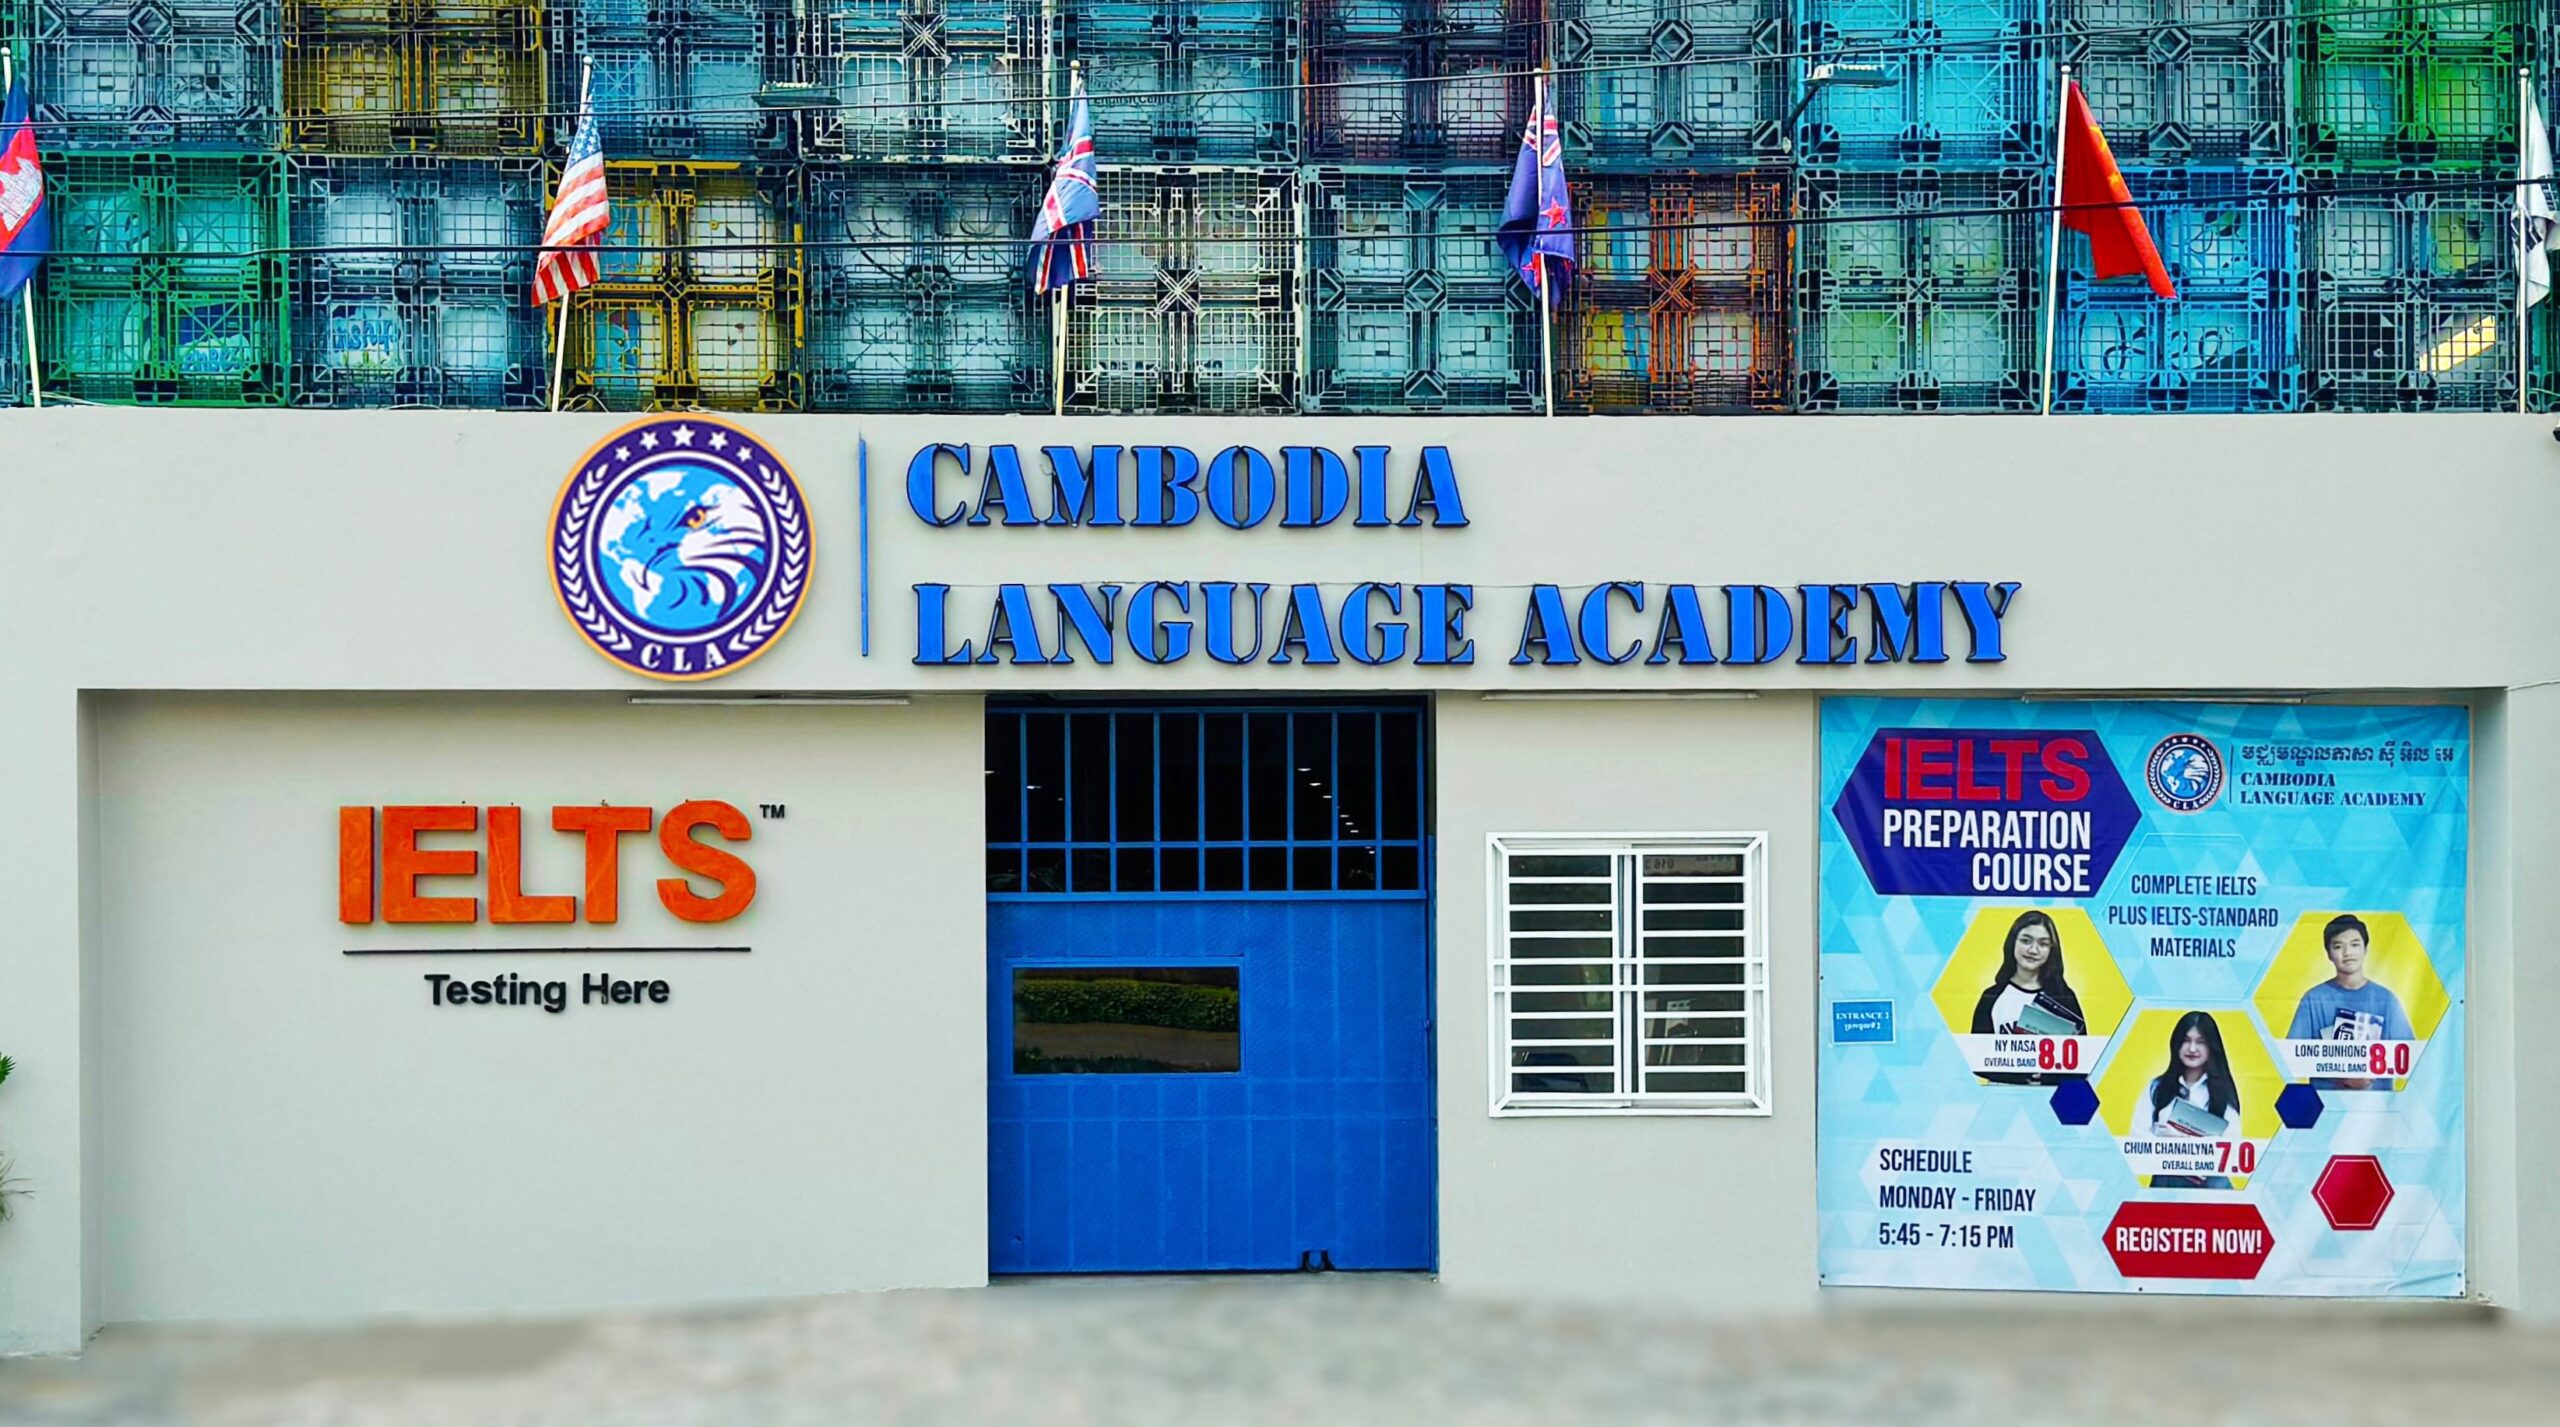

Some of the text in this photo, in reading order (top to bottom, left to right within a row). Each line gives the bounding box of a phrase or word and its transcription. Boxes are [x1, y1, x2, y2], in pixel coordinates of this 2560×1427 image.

[906, 443, 1470, 531] CAMBODIA
[912, 581, 2021, 667] LANGUAGE ACADEMY
[640, 641, 727, 672] CLA
[1885, 739, 2090, 801] IELTS
[2241, 773, 2335, 787] CAMBODIA
[2241, 791, 2426, 806] LANGUAGE ACADEMY
[1884, 809, 2090, 849] PREPARATION
[339, 799, 757, 928] IELTS
[1972, 853, 2090, 892] COURSE
[2132, 875, 2256, 895] COMPLETE IELTS
[2109, 906, 2278, 926] PLUS IELTS-STANDARD
[2151, 938, 2235, 957] MATERIALS
[424, 973, 670, 1013] Testing Here
[1836, 1012, 1882, 1020] ENTRANCE
[1995, 1040, 2036, 1052] NY NASA
[2039, 1038, 2079, 1070] 8.0
[2295, 1045, 2367, 1058] LONG BUNHONG
[1984, 1058, 2036, 1067] OVERALL BAND
[2316, 1063, 2367, 1072] OVERALL BAND
[2370, 1043, 2410, 1075] 8.0
[1880, 1148, 1972, 1174] SCHEDULE
[2124, 1142, 2214, 1155] CHUM CHANAILYNA
[2216, 1142, 2255, 1174] 7.0
[2162, 1160, 2214, 1170] OVERALL BAND
[1880, 1186, 1956, 1210] MONDAY
[1975, 1188, 2036, 1212] FRIDAY
[1880, 1223, 1920, 1246] 5:45
[1940, 1224, 1980, 1247] 7:15
[1987, 1225, 2014, 1248] PM
[2116, 1228, 2262, 1253] REGISTER NOW!
